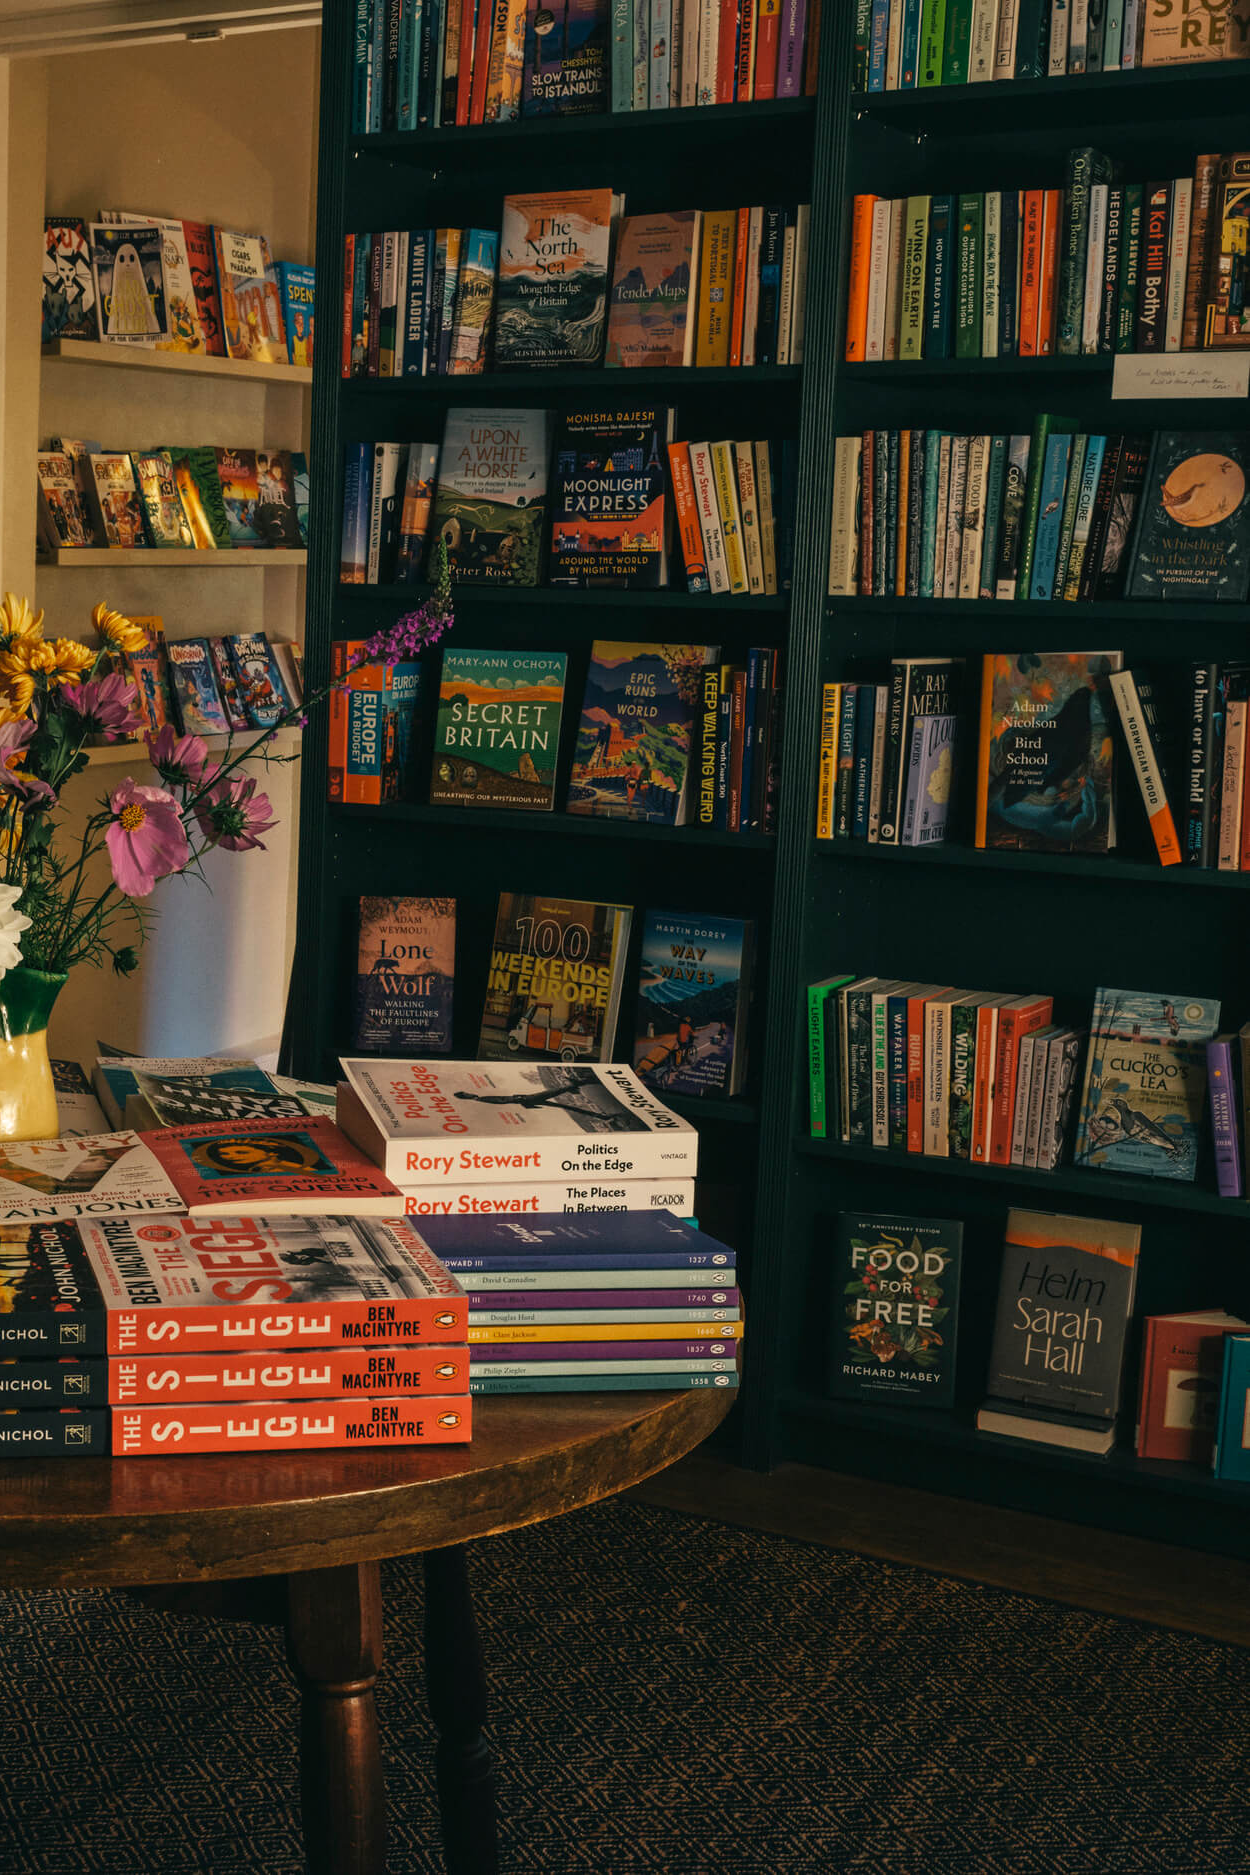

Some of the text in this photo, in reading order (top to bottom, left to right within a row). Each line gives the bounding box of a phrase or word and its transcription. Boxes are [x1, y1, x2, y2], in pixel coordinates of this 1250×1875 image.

[532, 69, 603, 88] SLOW TRAINS
[532, 81, 601, 96] TO ISTANBUL
[535, 218, 570, 237] The
[1106, 191, 1121, 282] HEDGELANDS
[232, 250, 250, 260] CIGARS
[526, 238, 578, 257] North
[230, 264, 257, 276] PHARAOH
[535, 258, 565, 276] Sea
[1140, 209, 1165, 326] Kat Hill Bothy
[408, 243, 424, 341] WHITE LADDER
[616, 285, 686, 300] Tender Maps
[566, 411, 655, 424] MONISHA RAJESH
[469, 429, 520, 446] UPON
[459, 447, 527, 463] A WHITE
[464, 463, 518, 480] HORSE
[563, 478, 651, 493] MOONLIGHT
[1078, 452, 1097, 522] NATURE CURE
[564, 494, 648, 512] EXPRESS
[447, 655, 562, 670] MARY-ANN OCHOTA
[630, 672, 655, 685] EPIC
[625, 684, 656, 697] RUNS
[451, 703, 548, 726] SECRET
[1010, 700, 1048, 714] Adam
[1002, 715, 1057, 729] Nicolson
[444, 728, 548, 750] BRITAIN
[700, 671, 719, 823] KEEP WALKING WEIRD
[1014, 736, 1042, 751] Bird
[1006, 752, 1048, 766] School
[1127, 716, 1158, 804] NORWEGIAN WOOD
[516, 916, 590, 965] 100
[655, 924, 726, 940] MARTIN DOREY
[380, 939, 433, 960] Lone
[491, 950, 610, 986] WEEKENDS
[380, 974, 436, 996] Wolf
[487, 969, 608, 1008] IN EUROPE
[951, 1032, 967, 1095] WILDING
[1110, 1058, 1189, 1080] CUCKOO'S
[1140, 1075, 1167, 1090] LEA
[577, 1144, 618, 1156] Politics
[405, 1150, 541, 1174] Rory Stewart
[561, 1158, 634, 1173] On the Edge
[566, 1187, 626, 1199] The Places
[650, 1194, 684, 1206] PICADOR
[404, 1195, 539, 1215] Rory Stewart
[851, 1248, 944, 1276] FOOD
[880, 1279, 912, 1294] FOR
[1018, 1262, 1106, 1306] Helm
[368, 1306, 395, 1320] BEN
[856, 1300, 934, 1328] FREE
[1014, 1297, 1103, 1344] Sarah
[119, 1314, 331, 1349] THE SIEGE
[342, 1321, 421, 1338] MACINTYRE
[1024, 1333, 1084, 1376] Hall
[842, 1365, 941, 1382] RICHARD MABEY
